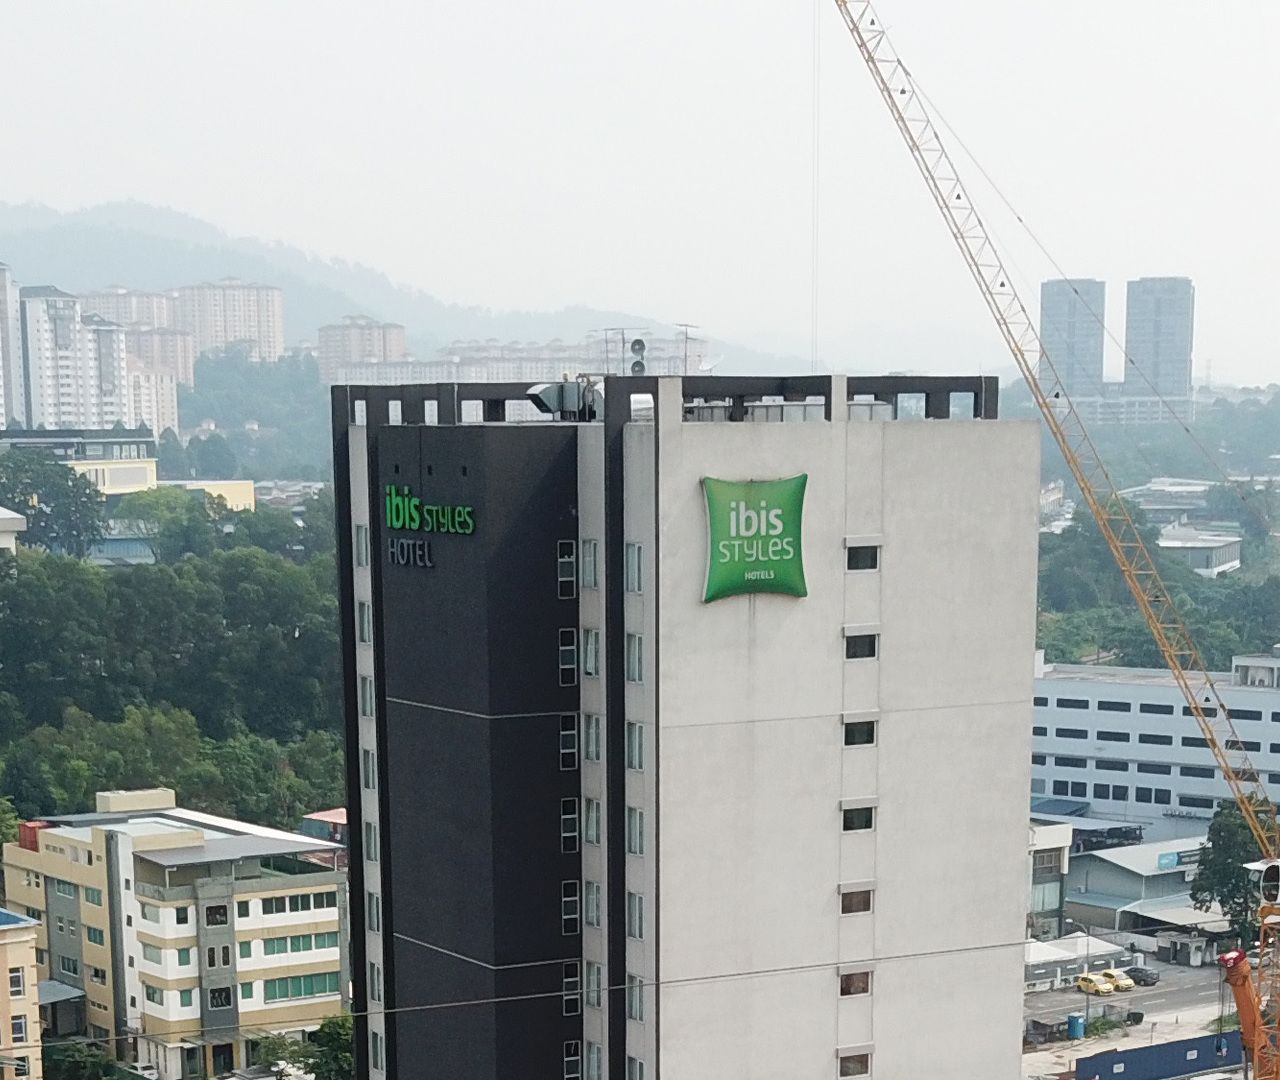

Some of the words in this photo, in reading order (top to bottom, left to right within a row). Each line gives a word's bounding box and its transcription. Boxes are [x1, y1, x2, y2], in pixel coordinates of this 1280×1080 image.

[385, 485, 420, 530] ibis
[729, 500, 784, 537] ibis
[388, 538, 432, 568] HOTEL
[744, 570, 775, 580] HOTELS
